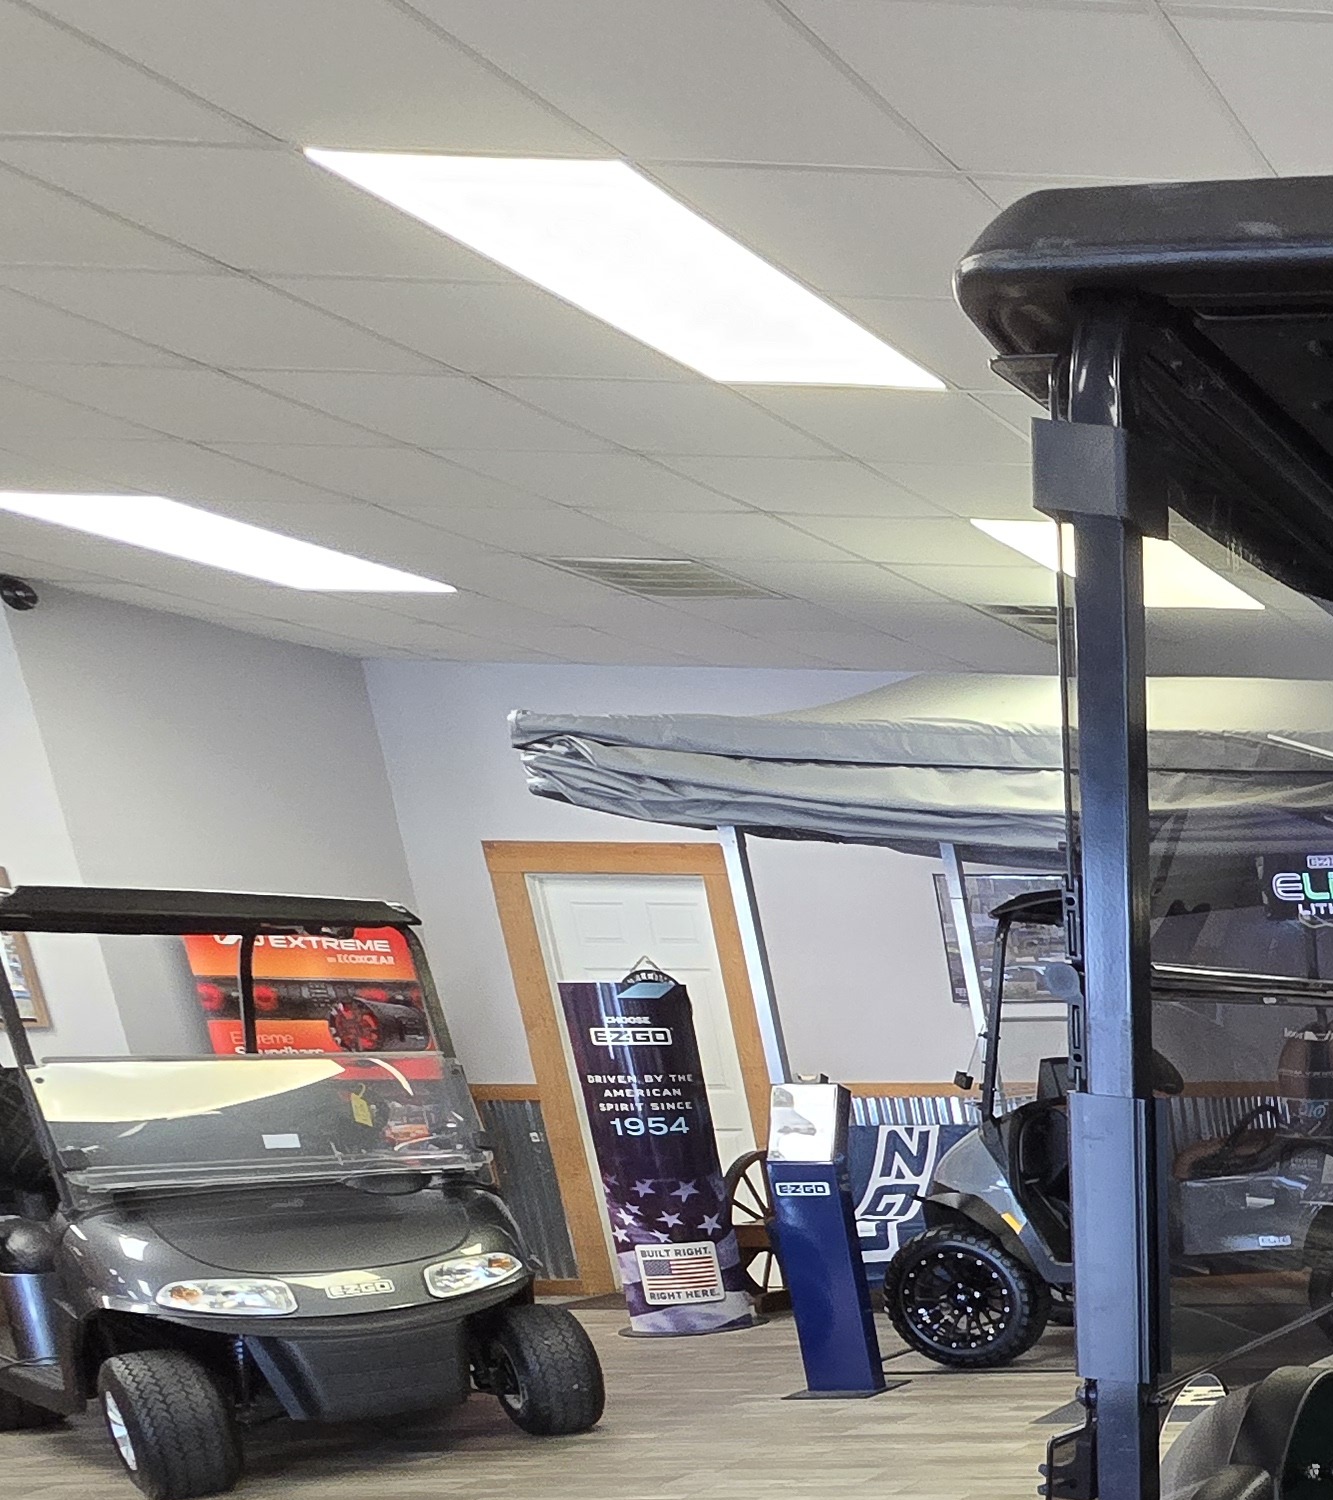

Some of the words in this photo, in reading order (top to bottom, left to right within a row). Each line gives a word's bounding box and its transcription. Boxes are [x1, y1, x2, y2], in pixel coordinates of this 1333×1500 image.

[269, 935, 391, 953] EXTREME
[230, 1031, 294, 1045] Ereme
[587, 1074, 637, 1084] DRIVEN
[644, 1075, 663, 1083] BY
[669, 1074, 693, 1082] THE
[603, 1088, 682, 1098] AMERICAN
[599, 1102, 644, 1112] SPIRIT
[650, 1102, 693, 1111] SINCE
[610, 1116, 690, 1136] 1954
[640, 1249, 671, 1258] BUILT
[674, 1246, 711, 1257] RIGHT.
[649, 1291, 682, 1300] RIGHT
[685, 1288, 720, 1299] HERE.
